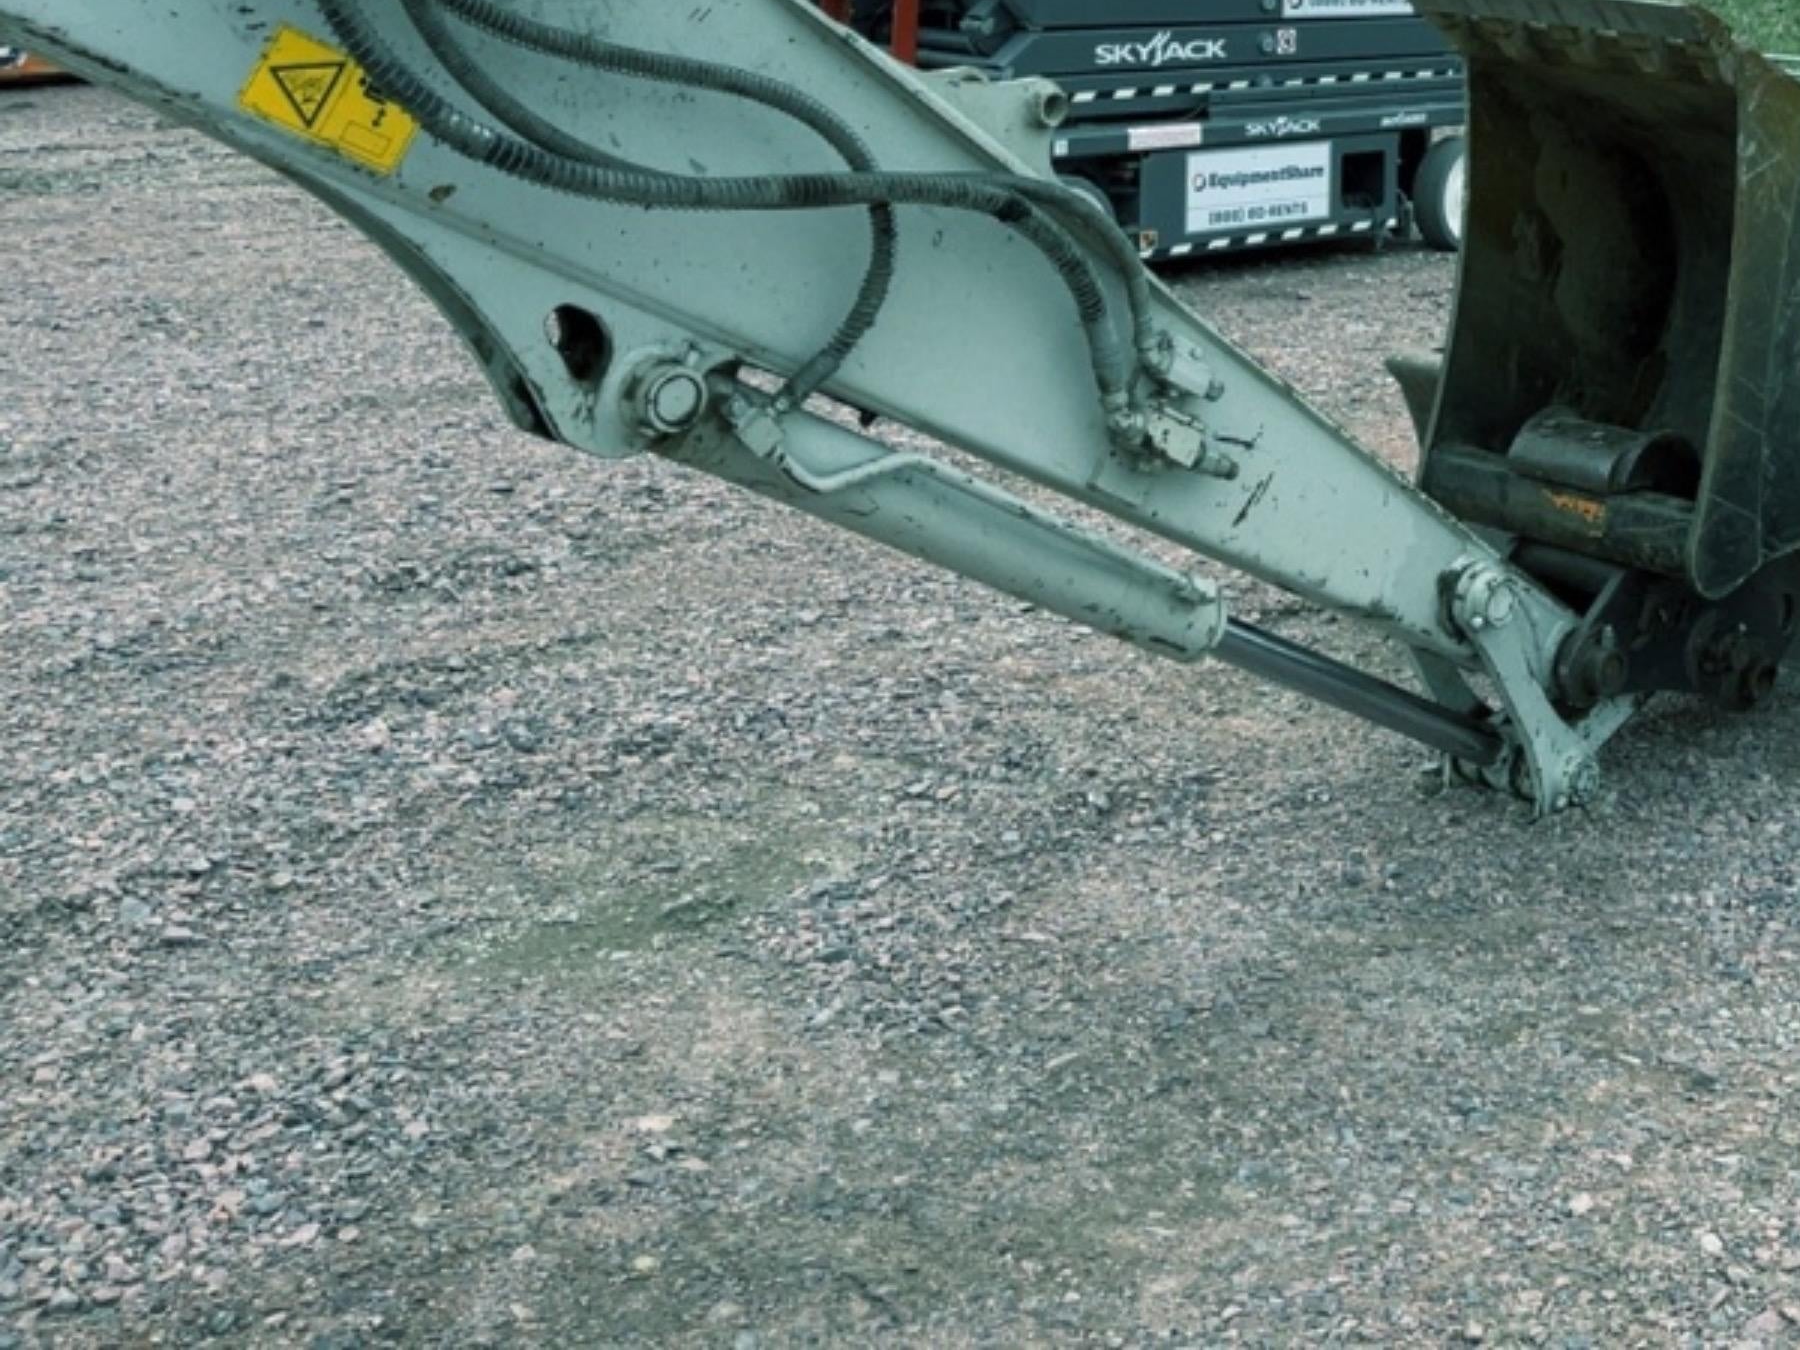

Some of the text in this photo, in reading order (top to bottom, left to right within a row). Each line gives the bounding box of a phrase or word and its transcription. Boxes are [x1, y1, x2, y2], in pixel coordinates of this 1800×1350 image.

[1093, 30, 1228, 67] SKYJACK
[1245, 115, 1321, 137] SKYJACK
[1208, 164, 1325, 191] EquipmentShare
